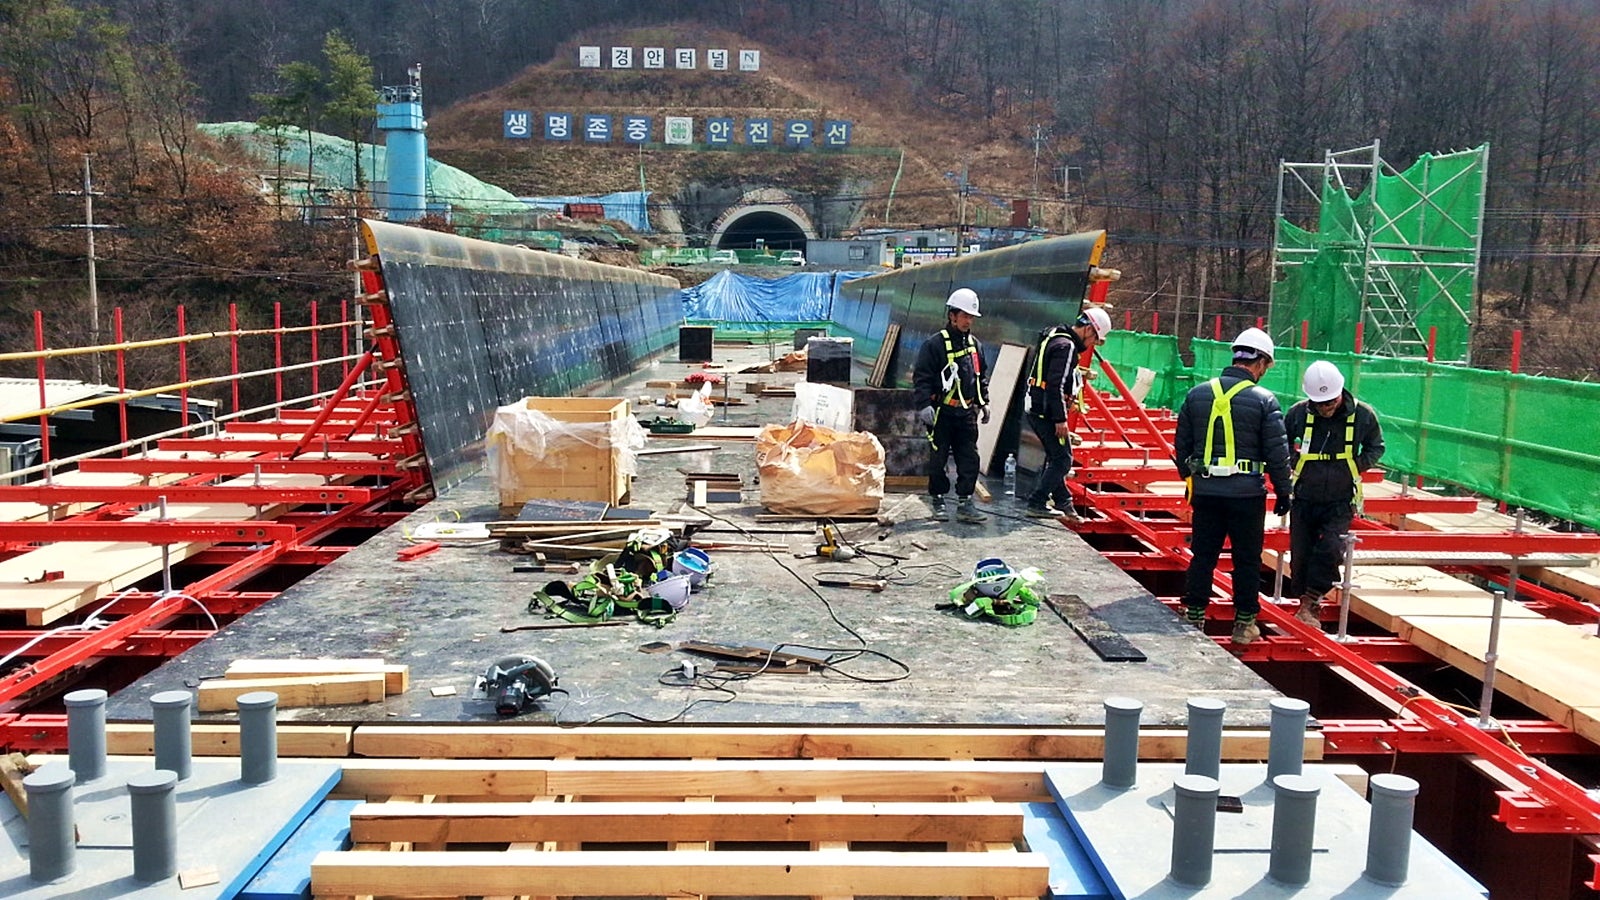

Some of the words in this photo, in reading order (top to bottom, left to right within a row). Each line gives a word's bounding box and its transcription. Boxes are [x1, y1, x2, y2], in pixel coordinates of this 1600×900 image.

[615, 49, 724, 68] 경안터널
[506, 113, 649, 140] 생명존중
[708, 120, 848, 146] 안전우선
